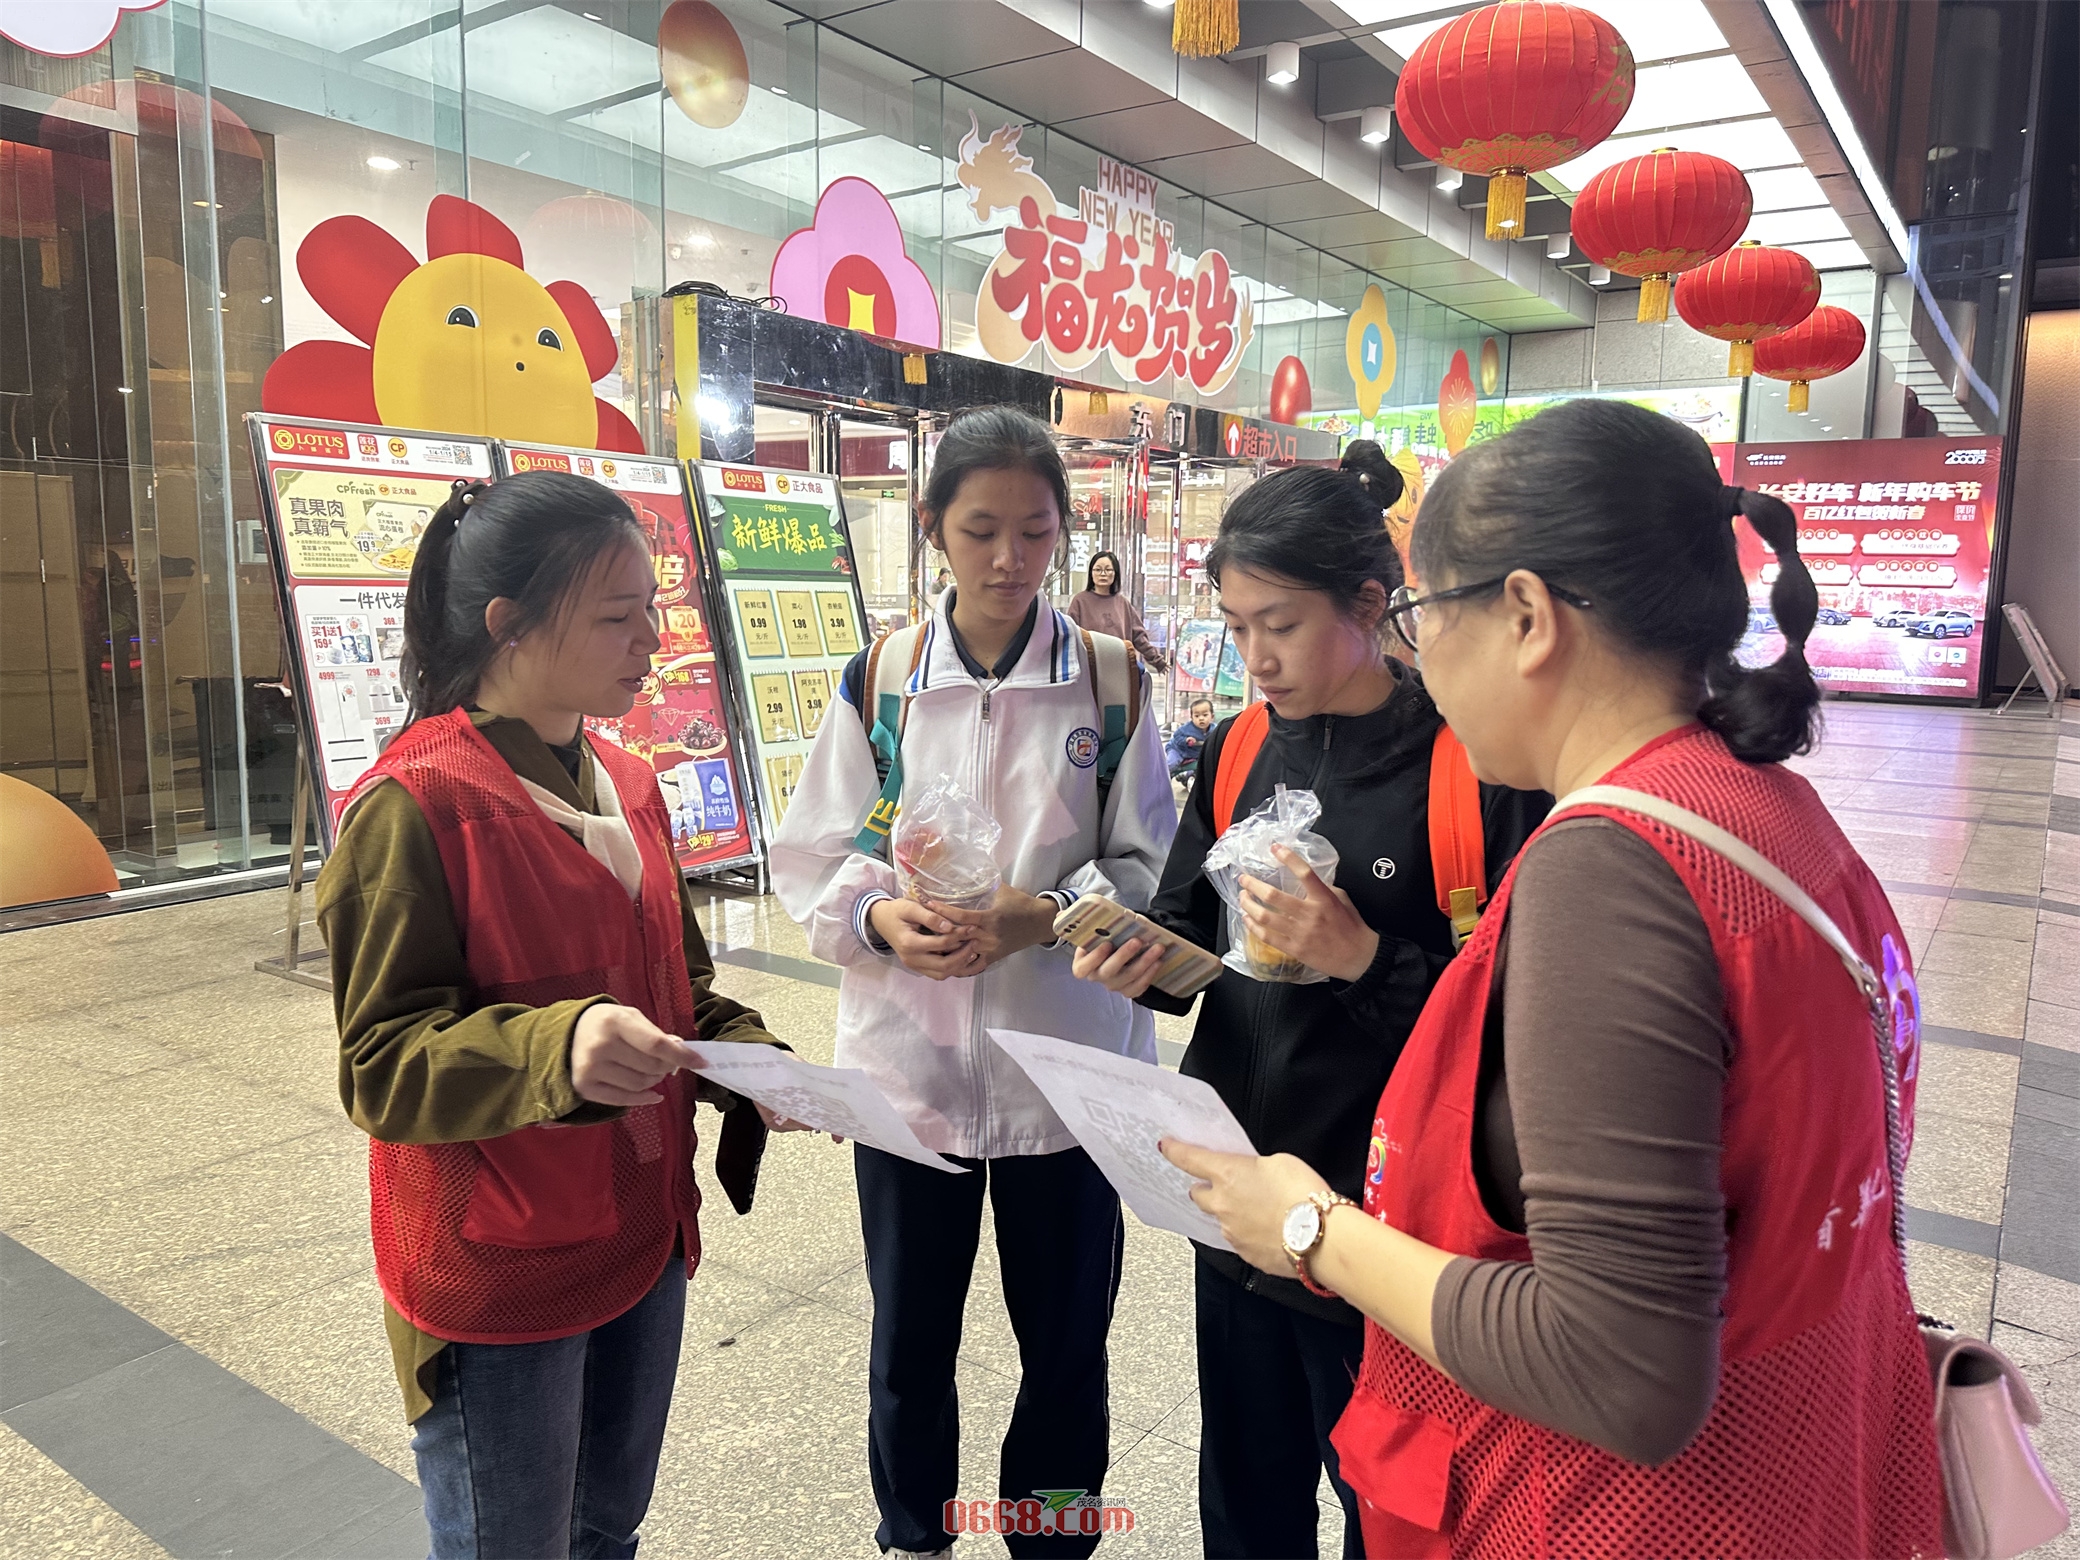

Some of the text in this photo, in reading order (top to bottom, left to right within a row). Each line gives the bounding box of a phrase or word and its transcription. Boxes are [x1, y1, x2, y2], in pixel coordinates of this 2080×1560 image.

[1098, 157, 1158, 210] HAPPY
[1081, 189, 1173, 254] NEW YEAR
[991, 196, 1237, 388] 福龙贺岁
[296, 433, 345, 448] LOTUS
[1242, 424, 1297, 463] 超市入口
[531, 457, 568, 470] LOTUS
[736, 474, 763, 485] LOTUS
[792, 480, 823, 494] 正大食品
[392, 486, 417, 496] 正大食品
[1858, 482, 1982, 502] 新年购车节
[289, 497, 344, 518] 真果肉
[765, 504, 788, 513] FRESH
[1803, 505, 1926, 521] 百亿红包贺新春
[292, 518, 348, 538] 真霸气
[731, 513, 827, 555] 新鲜爆品
[750, 617, 767, 628] 0.99
[311, 625, 343, 637] 买1送1
[767, 702, 783, 713] 2.99
[706, 805, 732, 818] 纯牛奶
